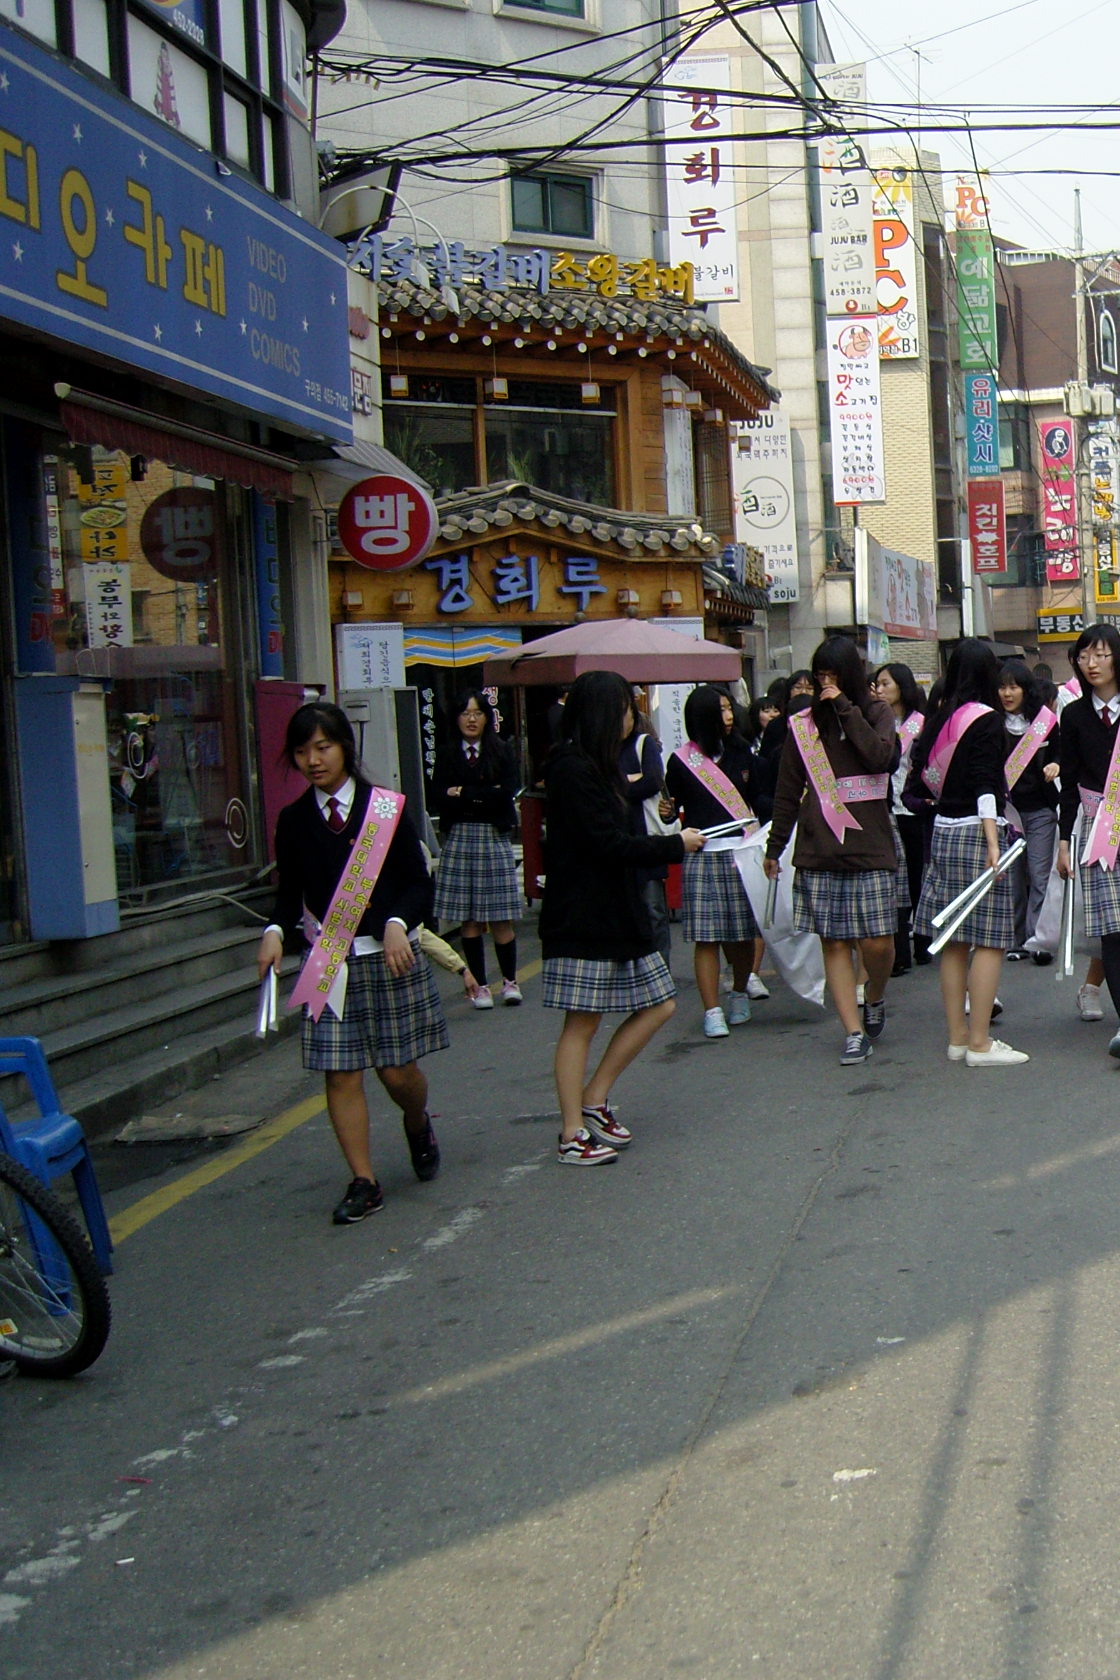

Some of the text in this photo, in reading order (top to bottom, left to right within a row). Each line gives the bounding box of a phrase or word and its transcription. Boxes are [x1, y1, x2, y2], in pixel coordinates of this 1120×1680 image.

[677, 91, 725, 249] 경회루
[955, 186, 991, 218] PC
[246, 234, 287, 284] VIDEO
[249, 281, 278, 322] DVD
[249, 329, 300, 378] COMICS
[902, 337, 918, 354] B1
[354, 493, 416, 556] 빵
[977, 545, 1000, 570] 호프
[423, 555, 608, 613] 경회루
[773, 586, 797, 600] soju
[319, 820, 380, 953] 동국대학교 사범대학
[316, 876, 375, 994] 부속여자 고등학교
